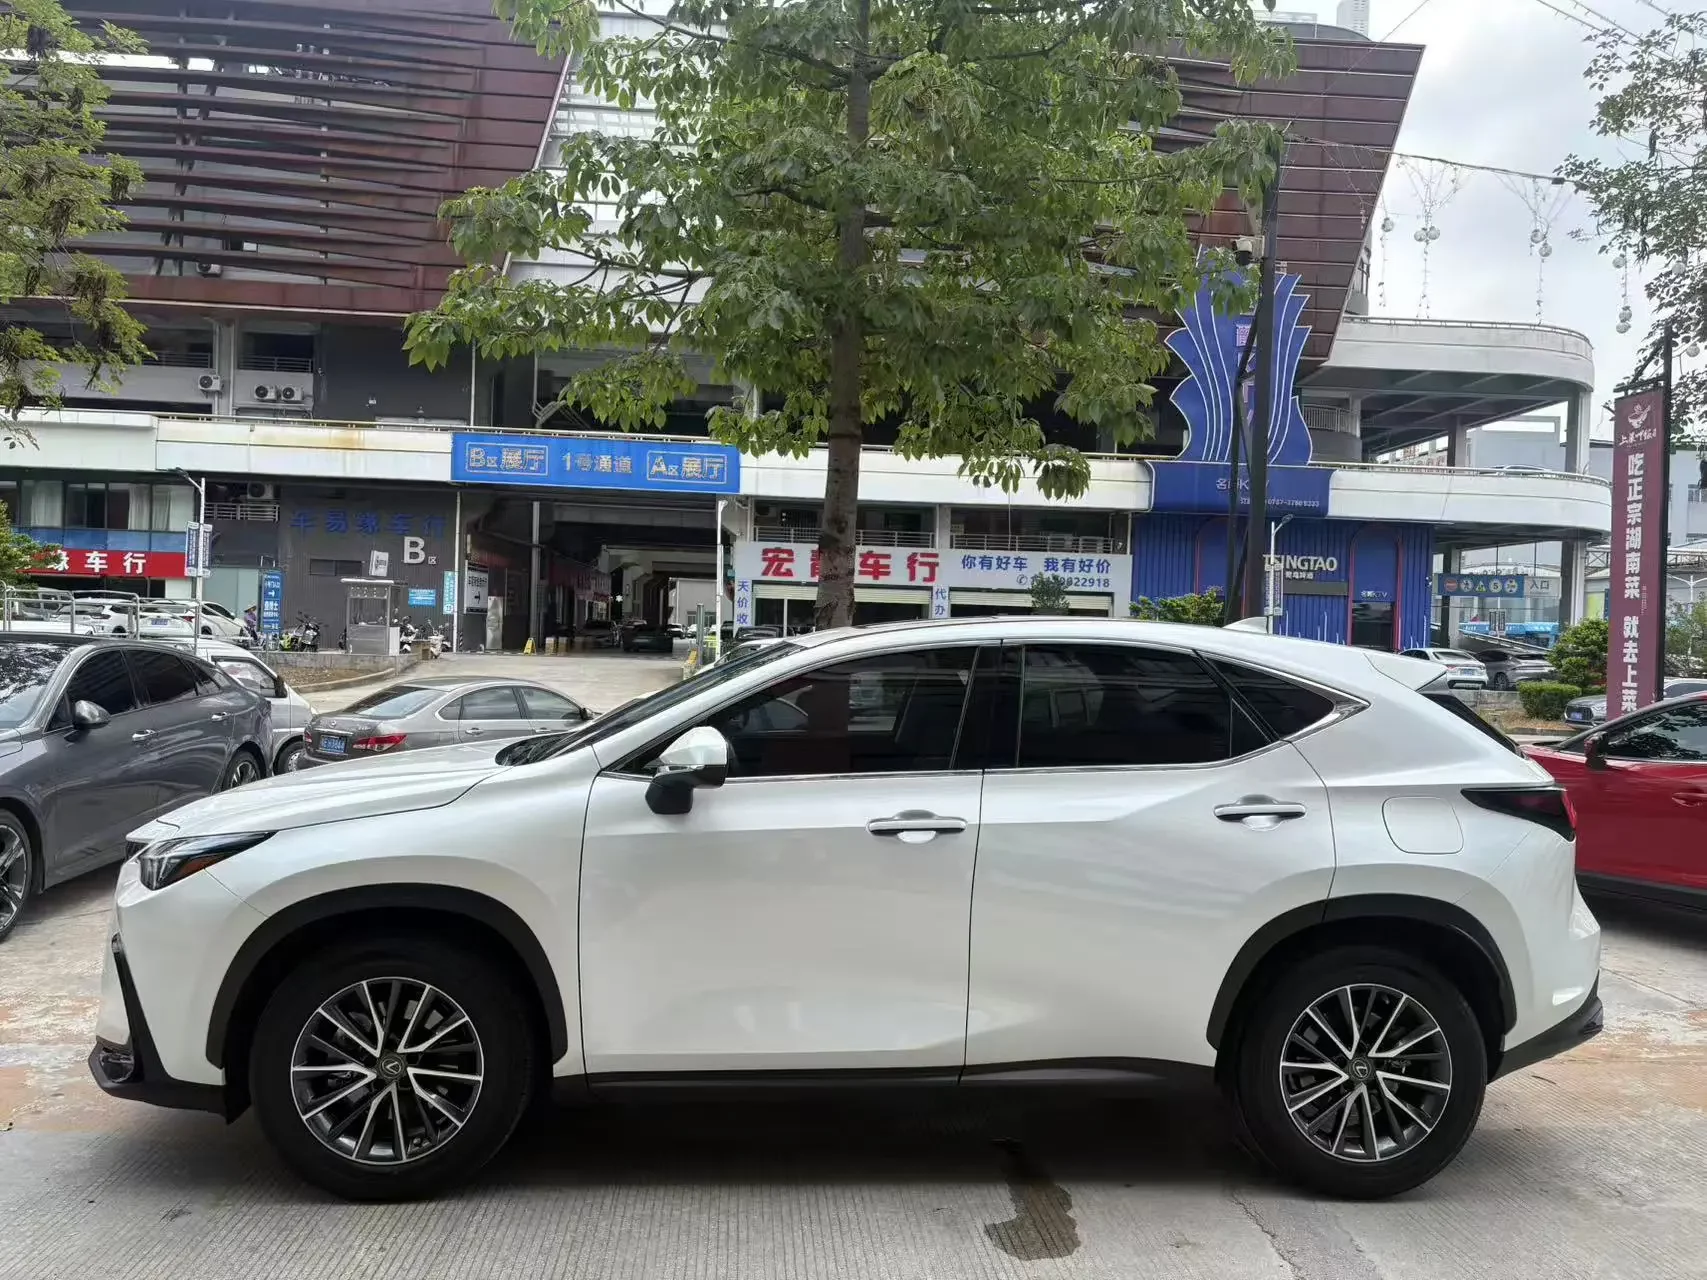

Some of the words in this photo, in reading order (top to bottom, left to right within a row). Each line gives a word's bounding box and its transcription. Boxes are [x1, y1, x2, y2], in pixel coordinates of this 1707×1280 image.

[469, 447, 545, 472] B区展厅
[561, 452, 633, 474] 1号通道
[650, 455, 725, 480] A区展厅
[1624, 453, 1645, 600] 吃正宗湖南菜
[962, 555, 1028, 571] 你有好车
[1044, 557, 1112, 574] 我有好价
[1530, 580, 1550, 590] 入口
[736, 580, 749, 625] 天价收
[934, 588, 946, 616] 代办
[1621, 615, 1640, 716] 就去上菜
